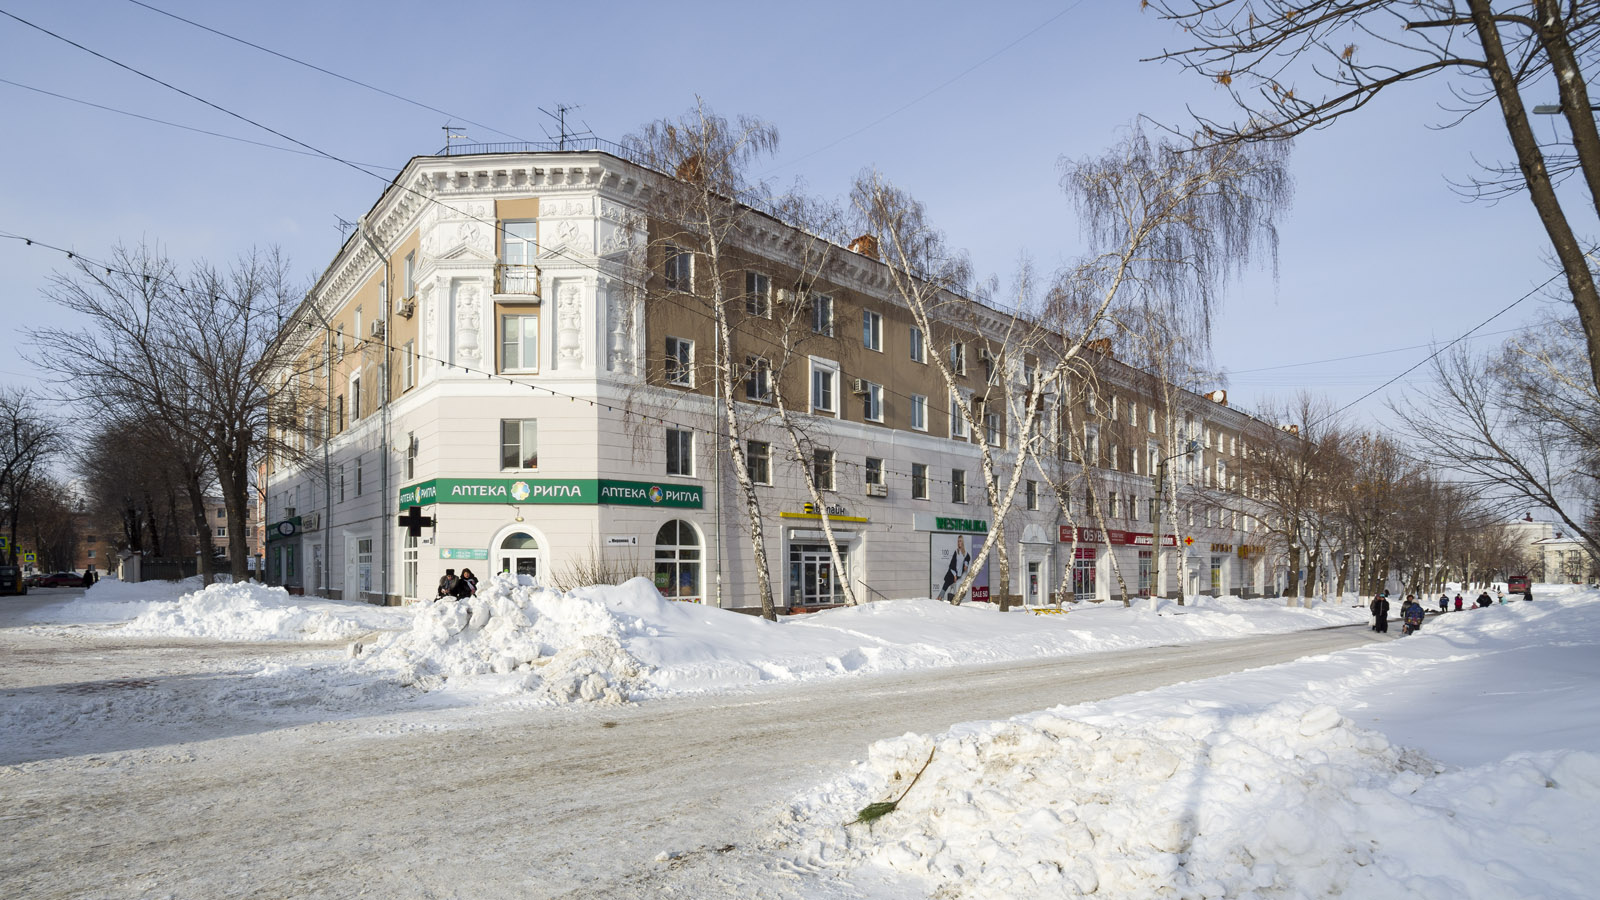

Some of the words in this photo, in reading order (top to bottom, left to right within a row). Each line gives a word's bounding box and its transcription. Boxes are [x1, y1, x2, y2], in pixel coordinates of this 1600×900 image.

[400, 492, 415, 504] АПТЕКА
[420, 486, 437, 500] РИГЛА
[451, 485, 507, 496] АПТЕКА
[533, 485, 582, 497] РИГЛА
[601, 486, 647, 499] АПТЕКА
[665, 490, 700, 503] РИГЛА
[935, 517, 988, 533] WESTFALIKA
